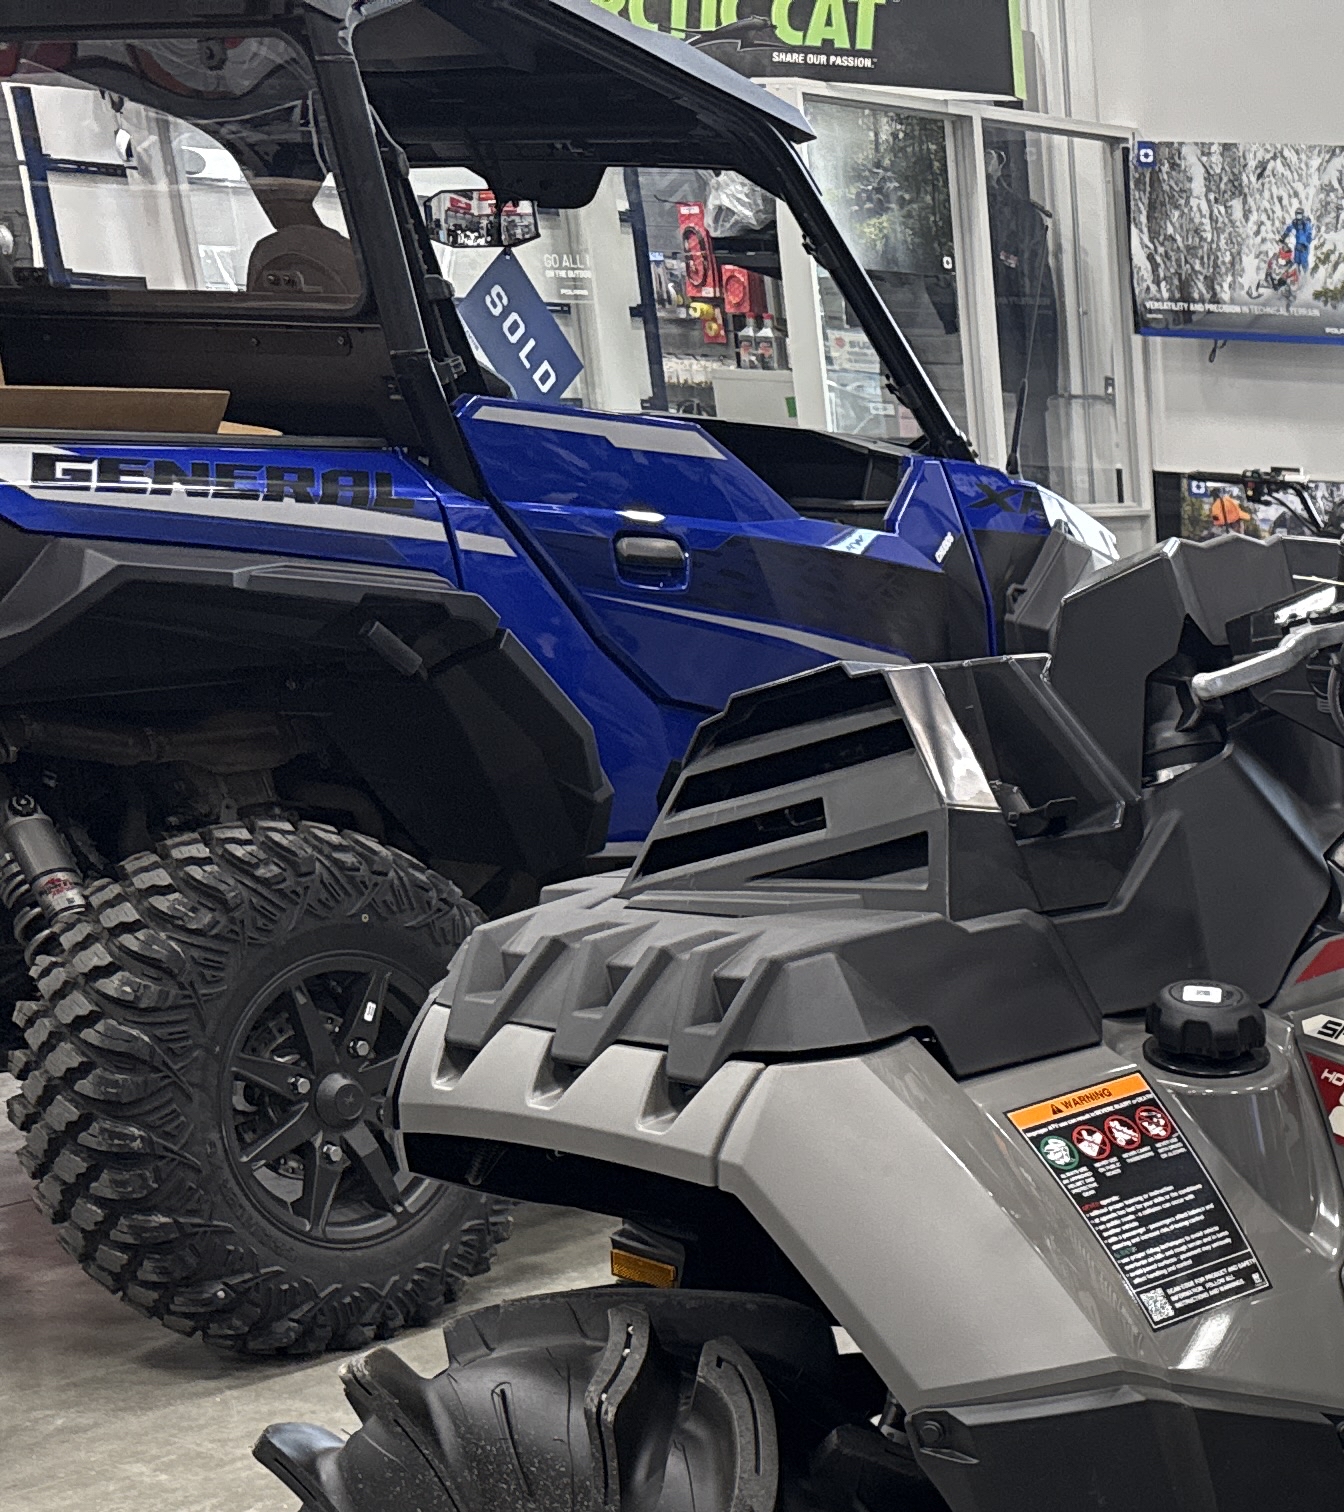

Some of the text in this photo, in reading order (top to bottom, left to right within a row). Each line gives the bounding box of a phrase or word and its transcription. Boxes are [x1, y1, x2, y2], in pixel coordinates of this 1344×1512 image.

[771, 0, 886, 50] CAT
[772, 52, 804, 63] SHARE
[806, 54, 827, 65] OUR
[485, 284, 558, 393] SOLD
[31, 453, 414, 510] GENERAL
[1060, 1088, 1112, 1110] WARNING
